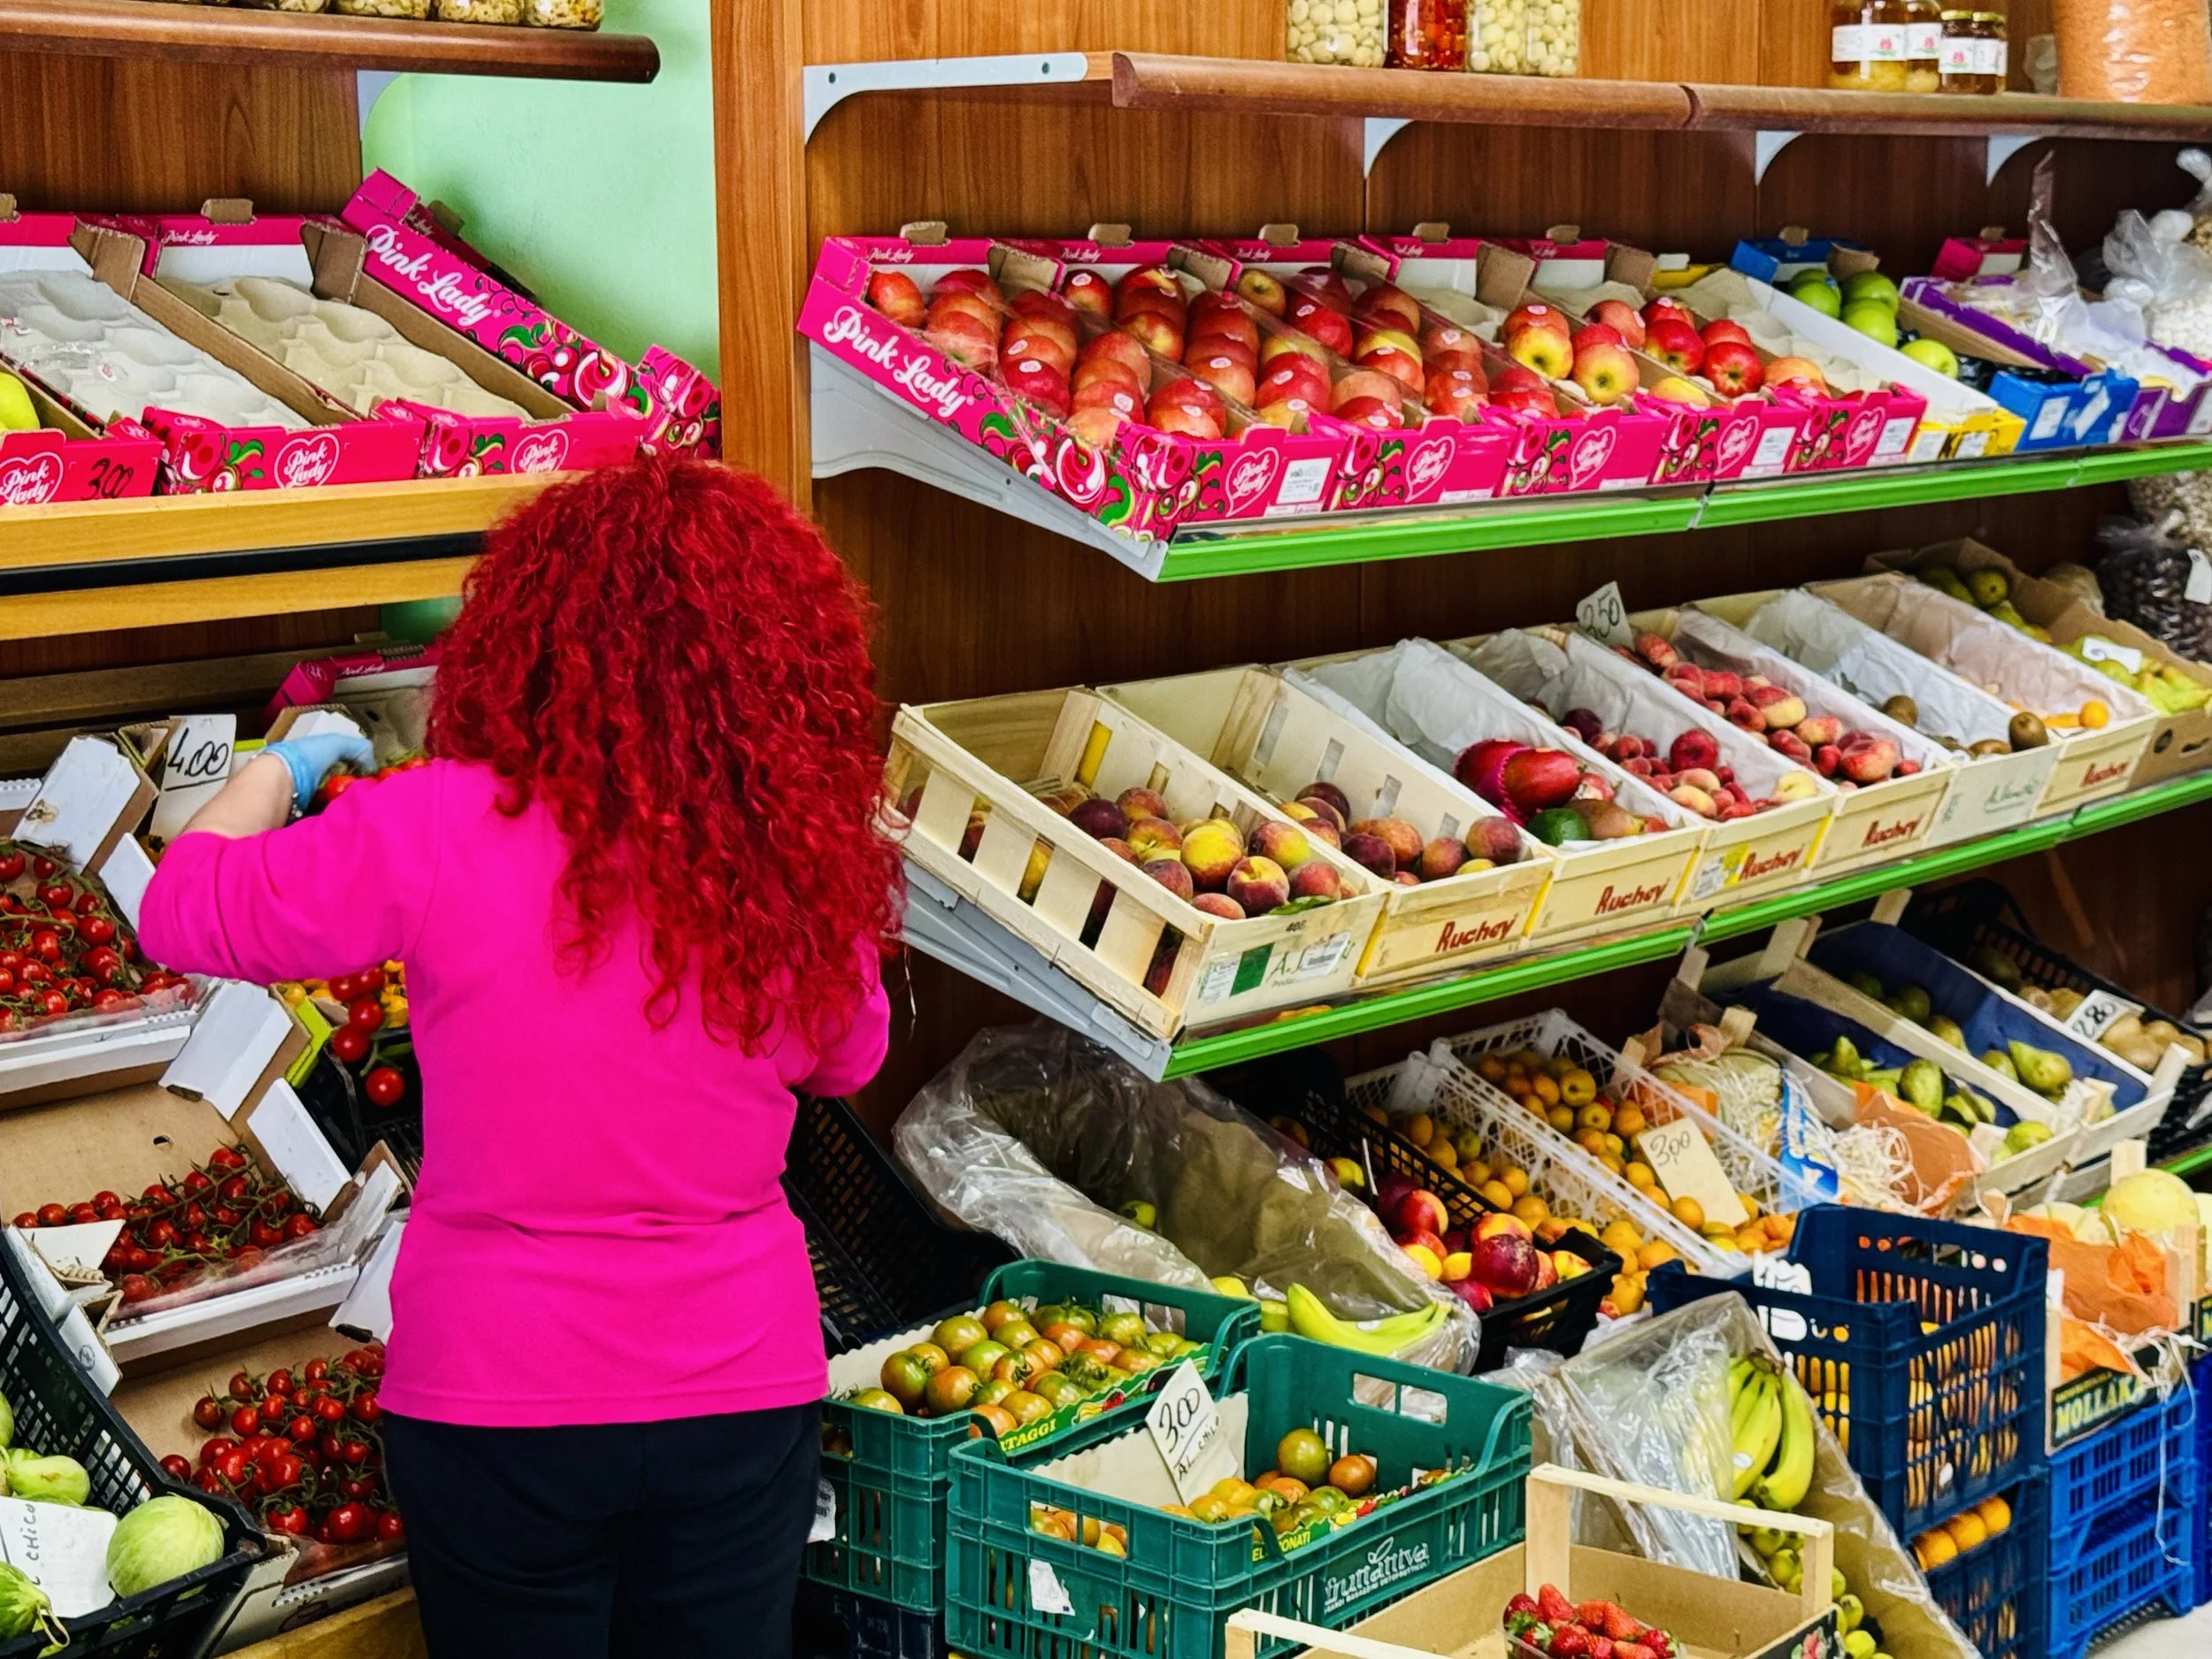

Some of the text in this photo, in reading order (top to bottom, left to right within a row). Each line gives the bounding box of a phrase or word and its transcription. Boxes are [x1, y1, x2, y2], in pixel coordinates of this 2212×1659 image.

[365, 224, 493, 327] Pink Lady
[823, 305, 967, 419] Pink Lady
[283, 441, 329, 476] Pink
[513, 437, 559, 467] Pink
[0, 459, 50, 495] Pink
[288, 461, 329, 488] Lady
[1233, 454, 1271, 487] Pink
[1233, 472, 1271, 499] Lady
[1740, 843, 1807, 881] Ruchey
[1595, 879, 1671, 915] Ruchey
[1435, 913, 1519, 953] Ruchey
